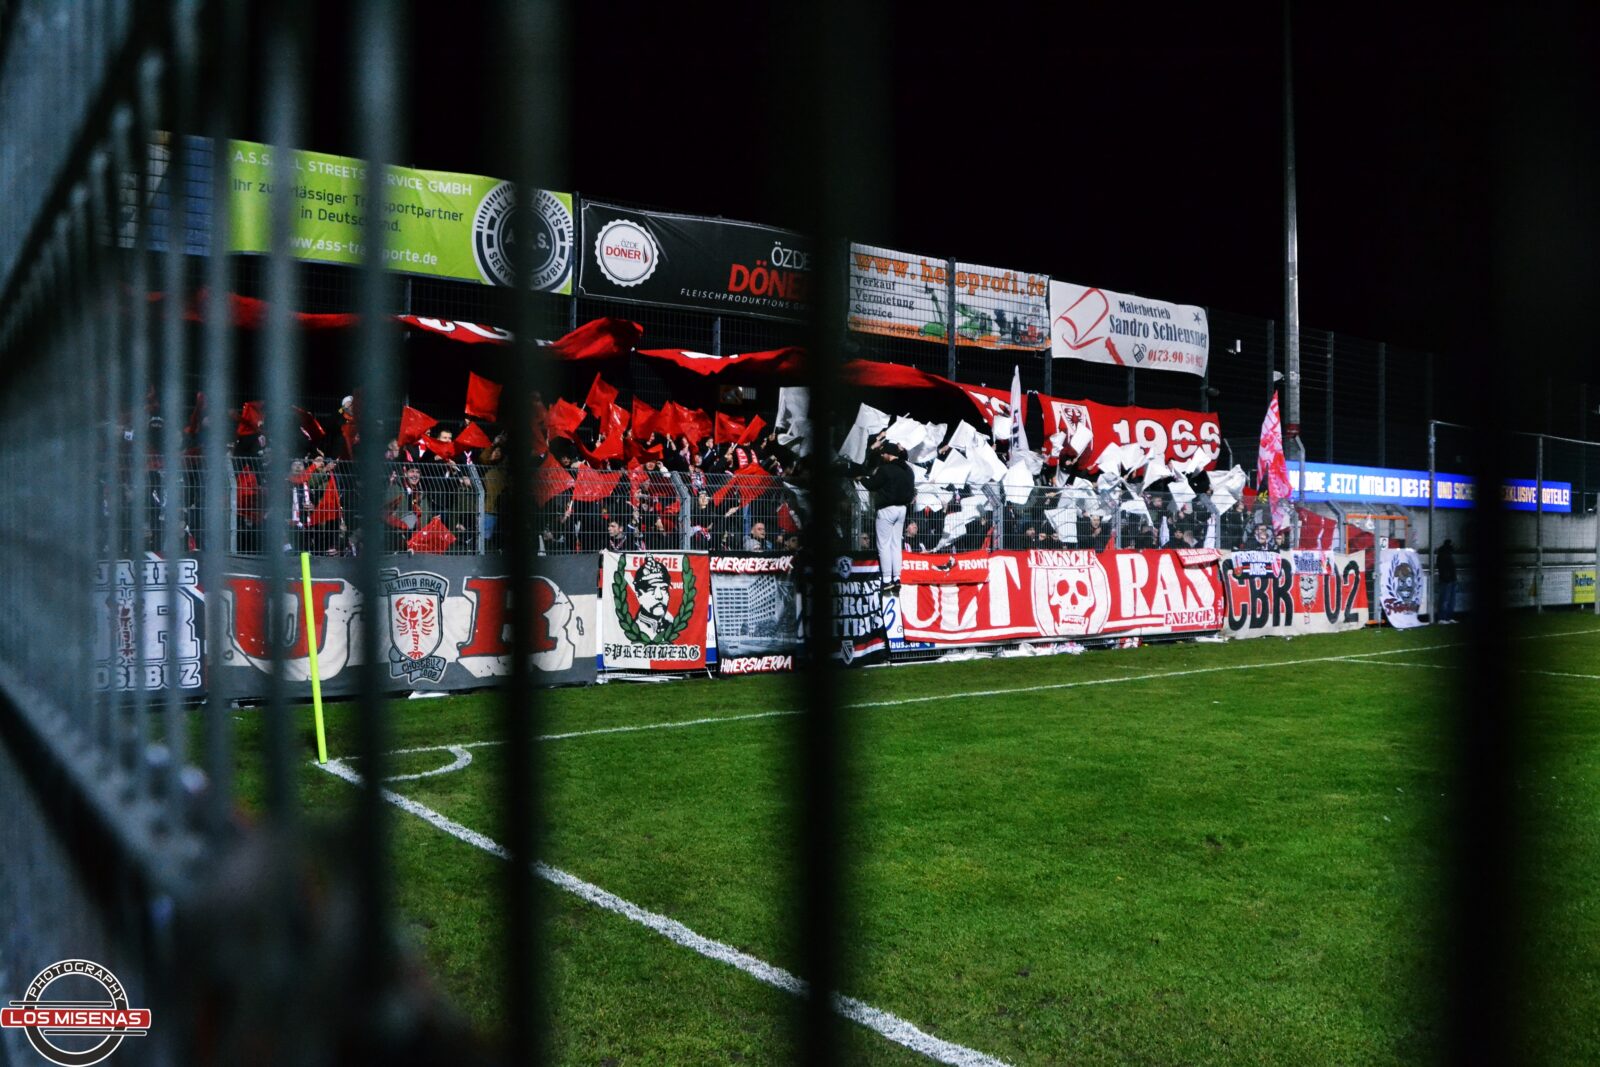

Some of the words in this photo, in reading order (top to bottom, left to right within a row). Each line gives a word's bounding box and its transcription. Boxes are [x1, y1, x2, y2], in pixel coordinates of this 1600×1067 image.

[233, 178, 252, 192] Ihr
[307, 161, 367, 181] STREETS
[381, 174, 424, 192] ERVICE
[428, 180, 473, 197] GMBH
[300, 206, 313, 219] in
[494, 196, 513, 218] ALL
[605, 243, 642, 261] DÖNER
[533, 261, 563, 286] GMBH
[727, 258, 802, 303] DÖNE
[855, 275, 897, 292] Verkauf
[855, 288, 915, 312] Vermietung
[855, 303, 893, 320] Service
[1118, 300, 1171, 320] Malerbetrieb
[1109, 313, 1150, 339] Sandro
[1152, 321, 1208, 349] Schleusner
[1289, 470, 1326, 493] WRDE
[1327, 473, 1358, 495] JETZT
[1358, 475, 1401, 497] MITGLIED
[1401, 478, 1419, 498] DES
[1541, 487, 1570, 506] ORTEILE!
[710, 555, 794, 574] ENERGIEBEZIRK
[1165, 608, 1213, 627] ENERGIE
[604, 643, 701, 661] SPREMBERG
